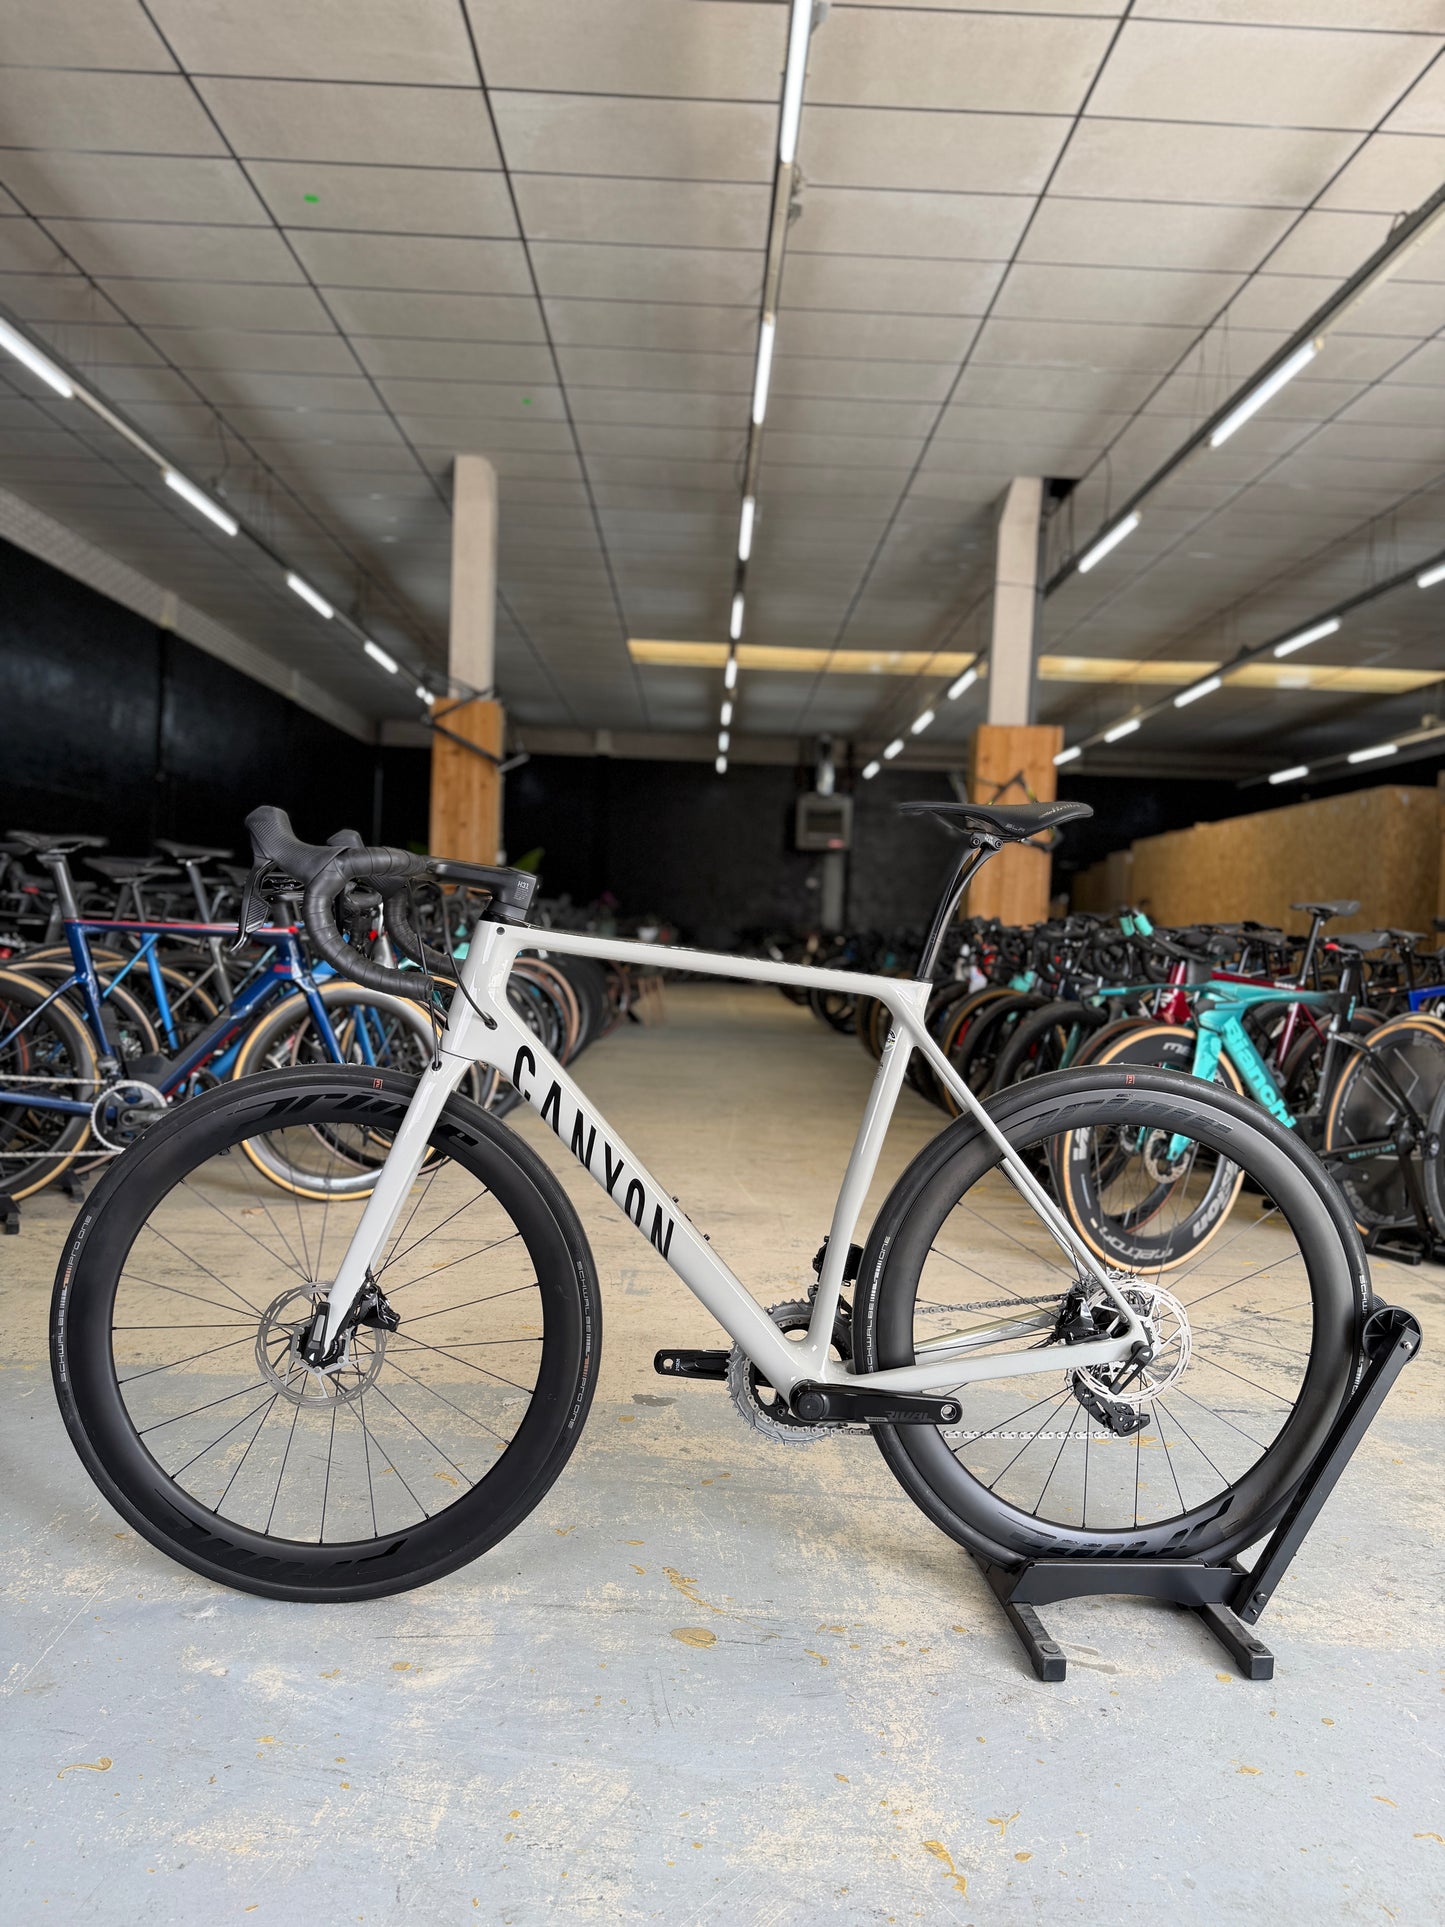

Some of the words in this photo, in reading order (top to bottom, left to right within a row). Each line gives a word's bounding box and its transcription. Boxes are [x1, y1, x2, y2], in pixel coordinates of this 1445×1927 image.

[517, 880, 529, 890] H31
[1223, 1016, 1297, 1129] Bianchi
[513, 1045, 674, 1261] CANYON
[576, 1260, 592, 1333] SCHWALBE
[56, 1308, 67, 1383] SCHWALBE
[865, 1302, 875, 1373] SCHWALBE
